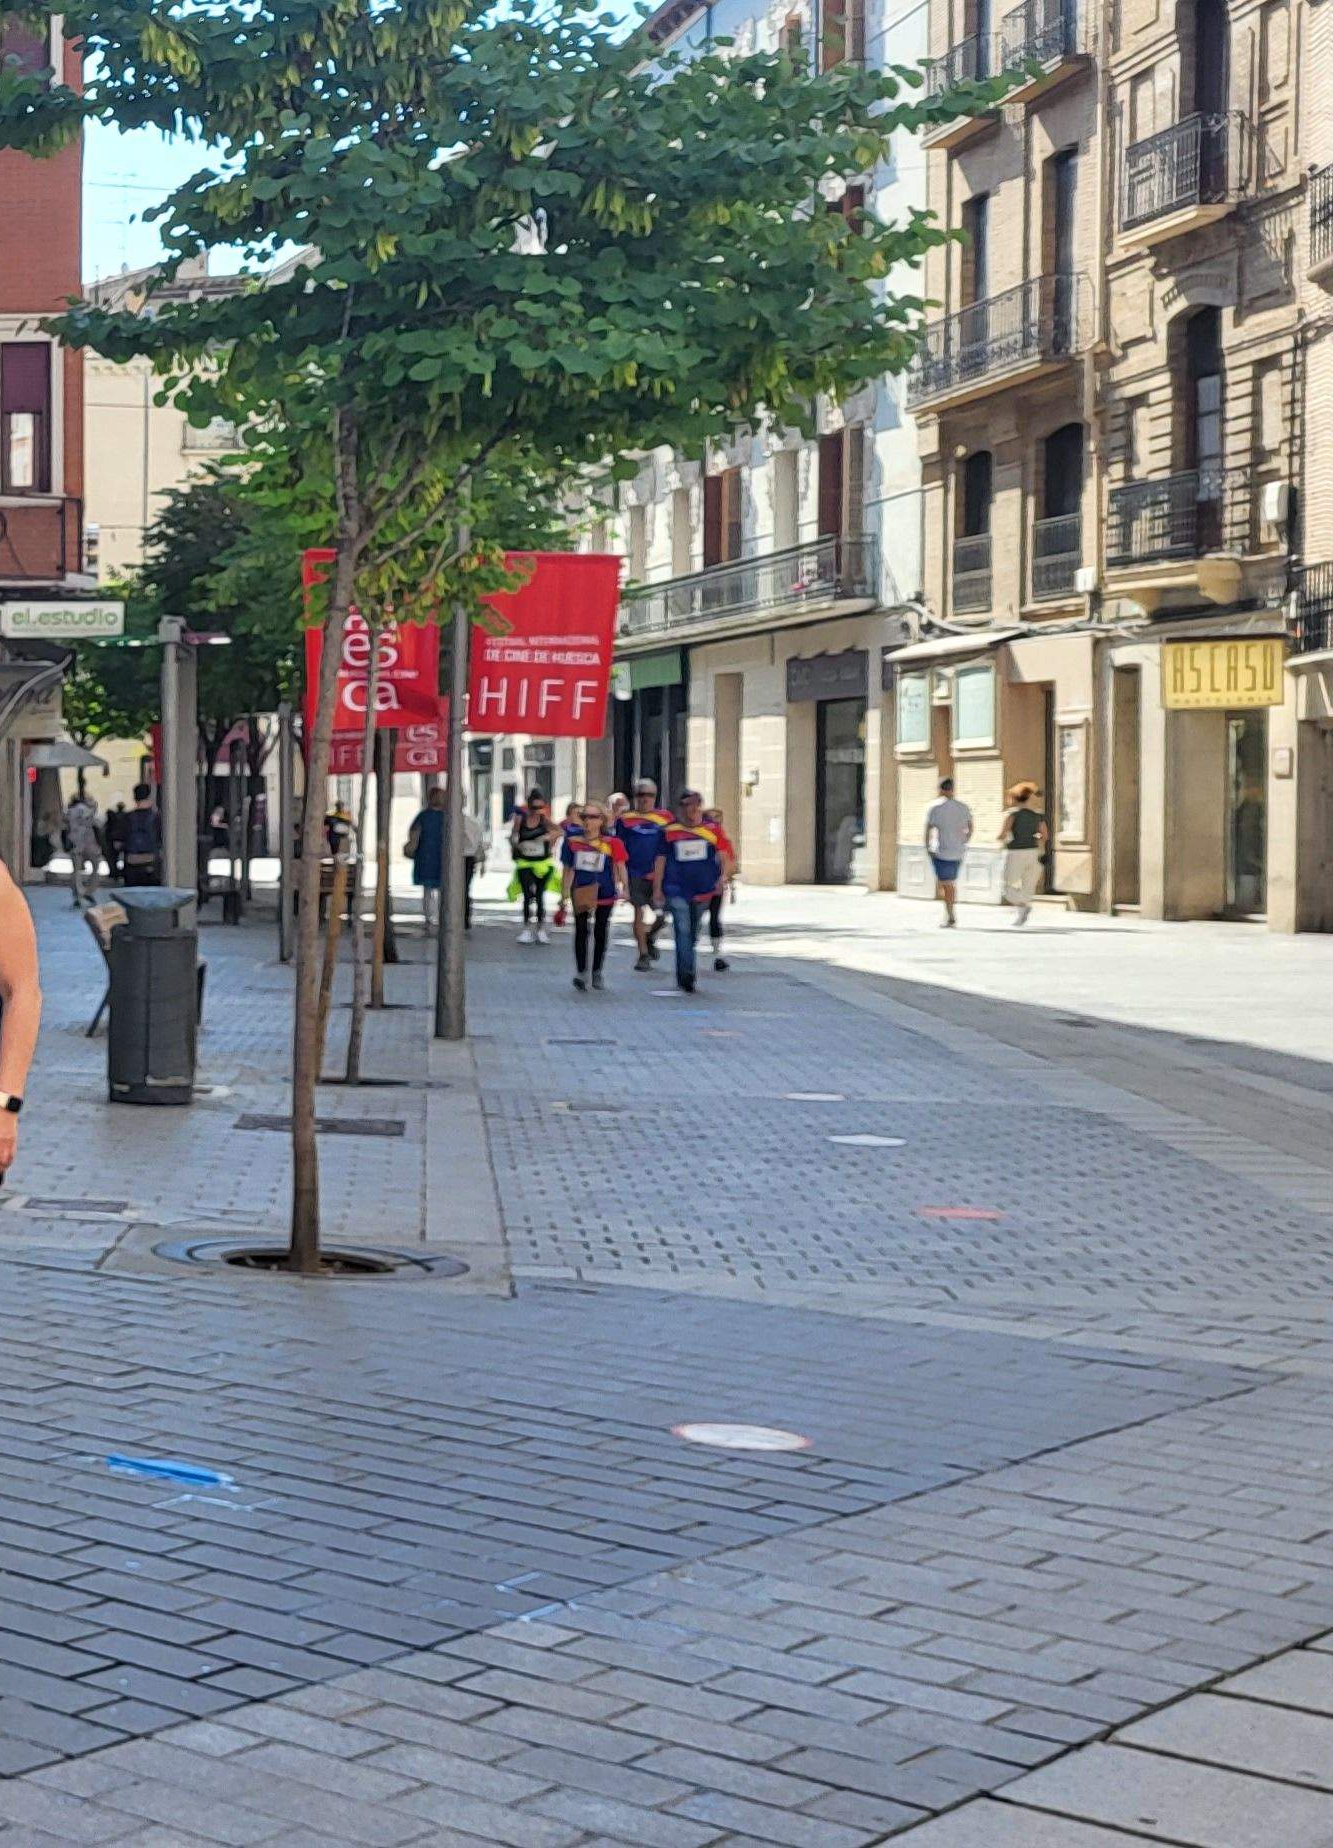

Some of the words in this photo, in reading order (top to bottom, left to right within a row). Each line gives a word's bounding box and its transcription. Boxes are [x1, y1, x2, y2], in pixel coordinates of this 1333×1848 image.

[11, 607, 119, 626] el.estudio
[486, 648, 501, 662] DE
[504, 648, 530, 663] CINE
[534, 650, 549, 664] DE
[552, 651, 601, 666] HUESCA
[1173, 643, 1274, 693] ASCASO
[478, 675, 599, 720] HIFF
